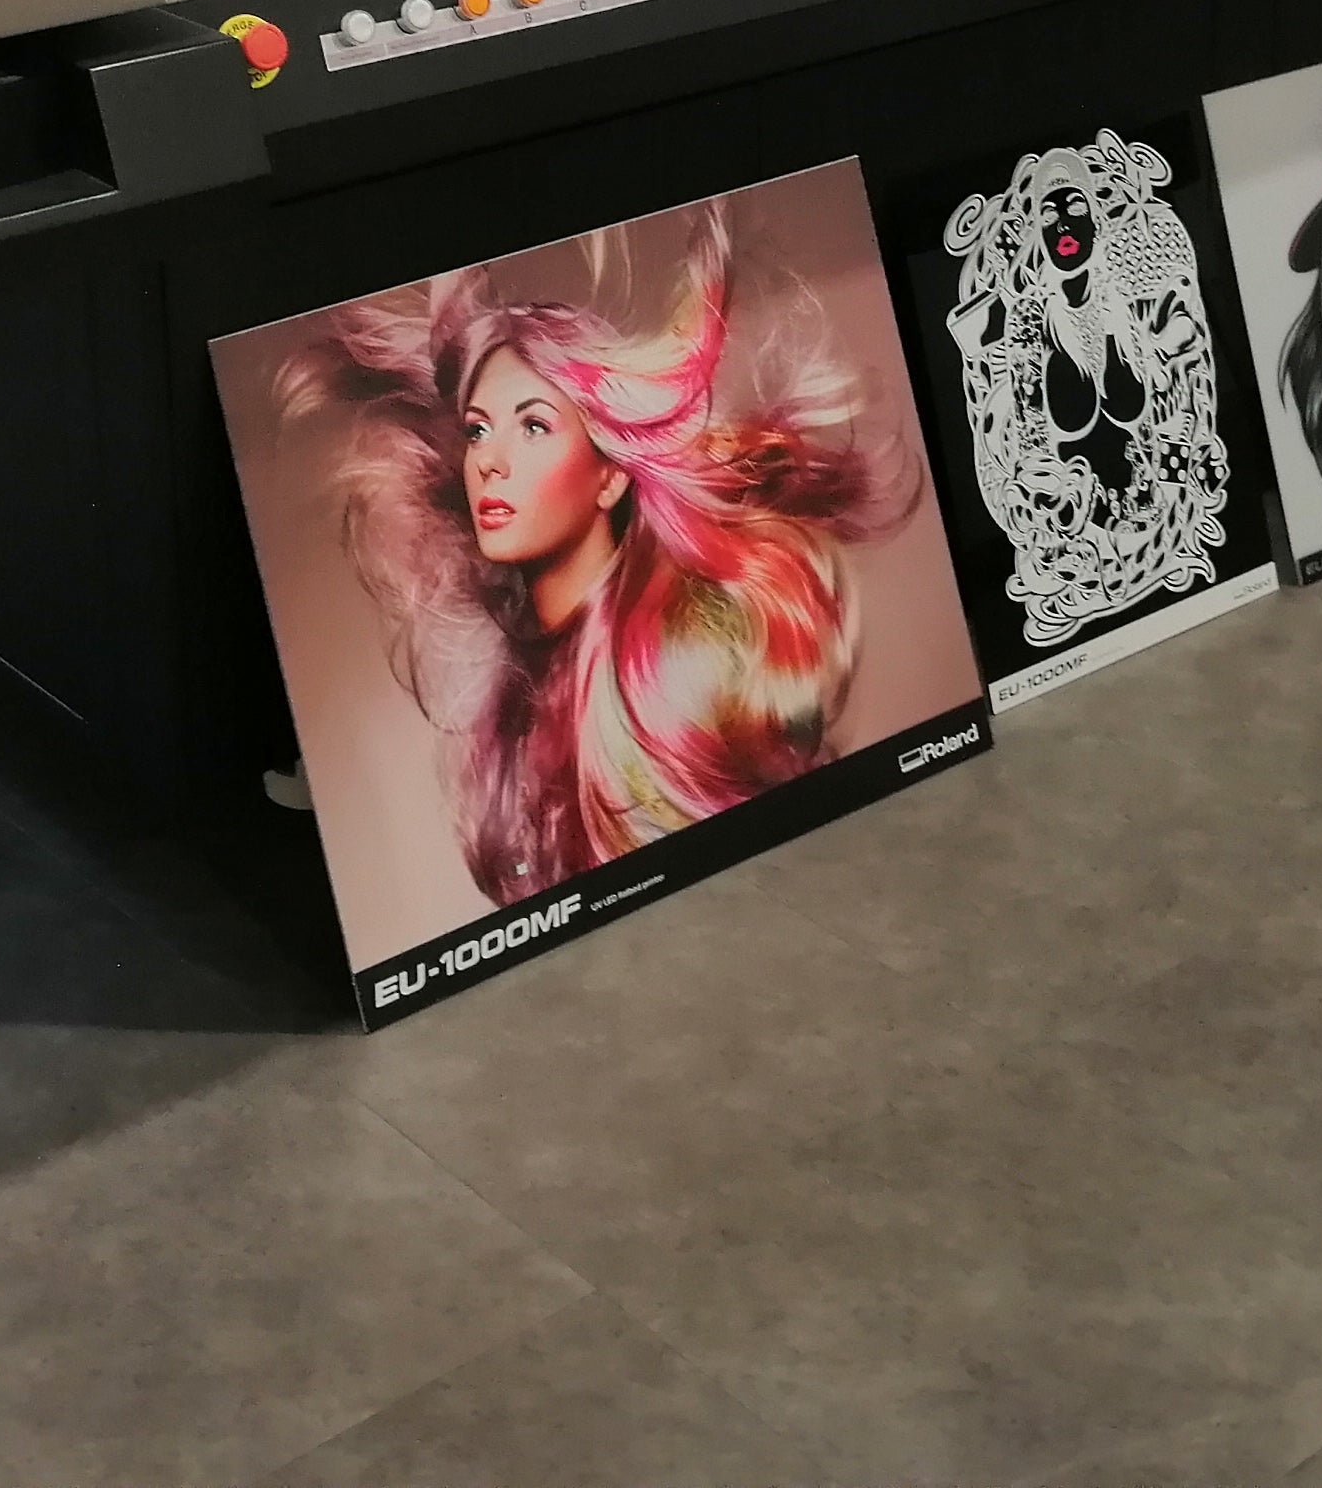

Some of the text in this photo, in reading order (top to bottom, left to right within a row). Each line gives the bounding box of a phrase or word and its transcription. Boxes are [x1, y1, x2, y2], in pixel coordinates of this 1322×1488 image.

[470, 24, 478, 36] A
[525, 12, 533, 24] B
[997, 653, 1088, 702] EU-1000MF
[374, 893, 582, 1008] EU-1000MF
[921, 722, 980, 763] Roland
